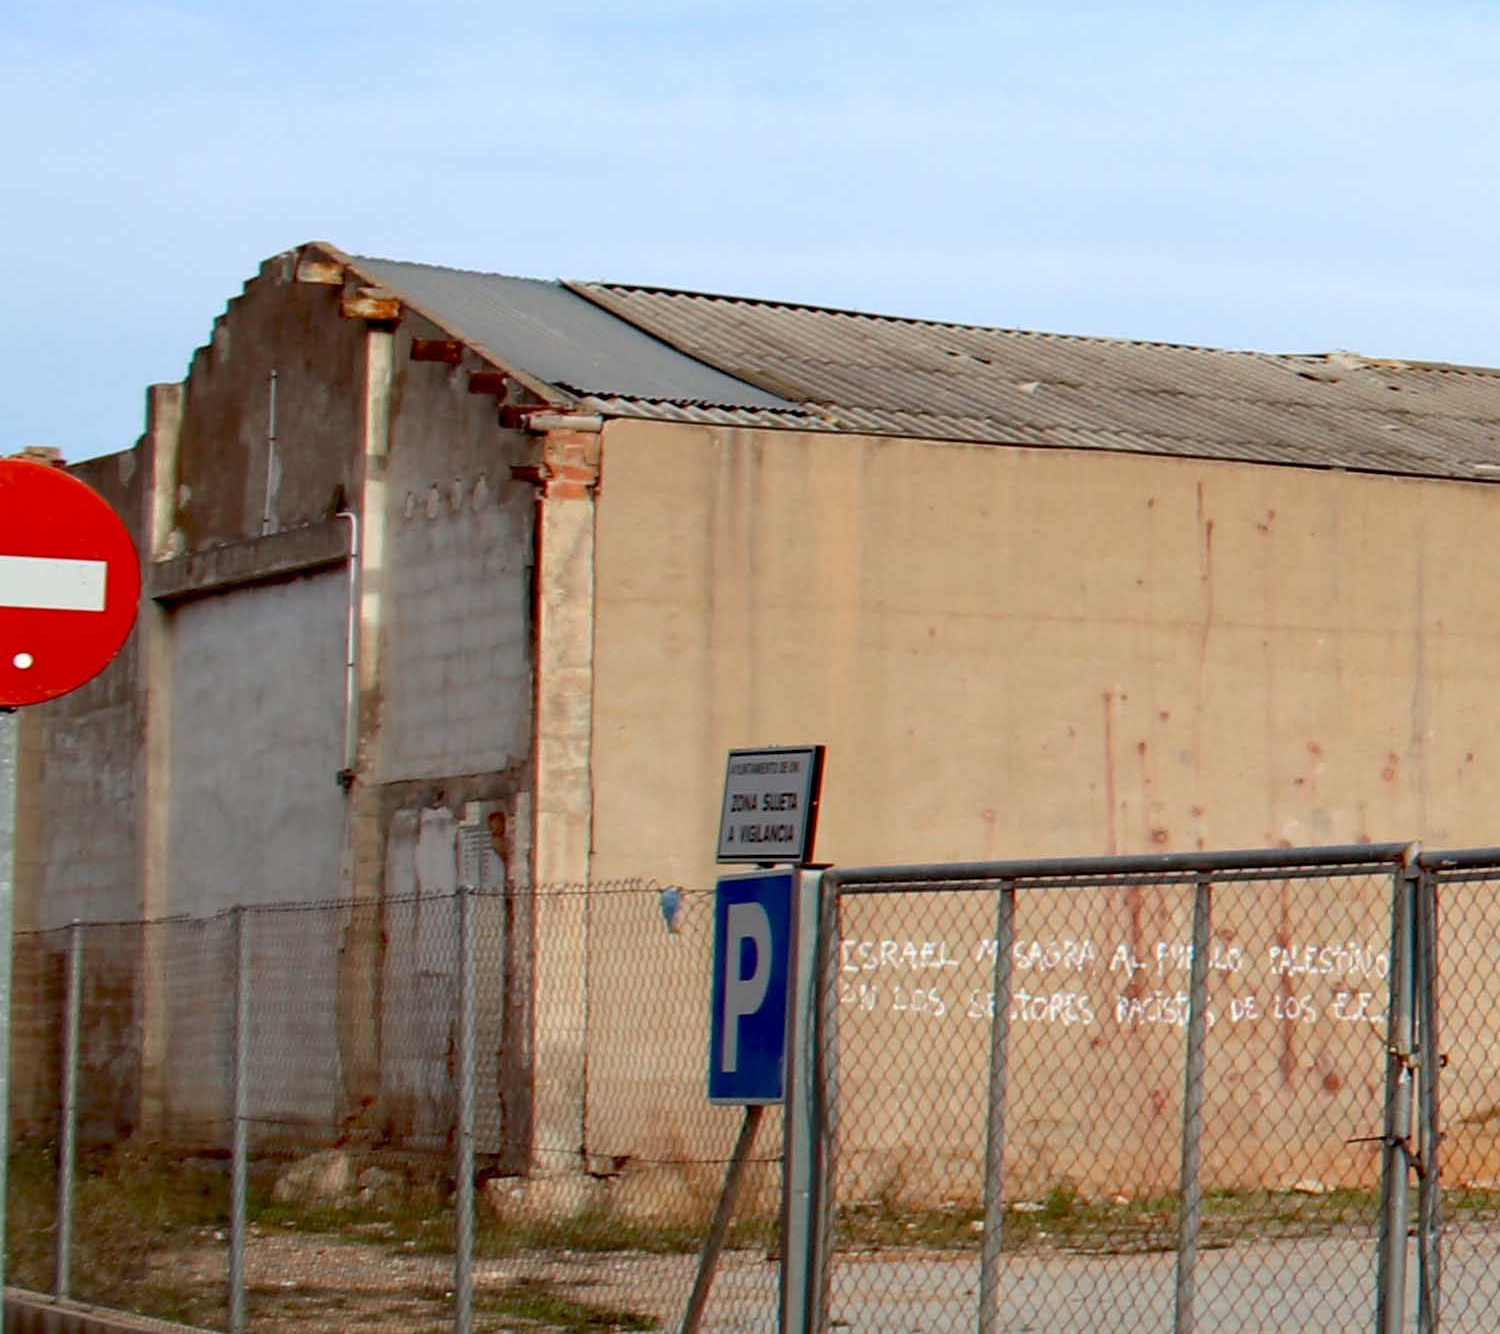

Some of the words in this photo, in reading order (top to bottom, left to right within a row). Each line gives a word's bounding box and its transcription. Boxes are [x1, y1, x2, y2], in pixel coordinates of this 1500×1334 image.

[731, 794, 758, 812] ZONA
[727, 826, 735, 842] A
[740, 824, 794, 843] VIGILANCIA
[841, 939, 960, 972] ISRAEL
[1109, 944, 1147, 978] AL
[1269, 942, 1389, 979] PALESTINO
[721, 901, 773, 1073] P
[893, 985, 946, 1017] LOS
[1231, 995, 1259, 1023] DE
[1274, 994, 1316, 1024] LOS
